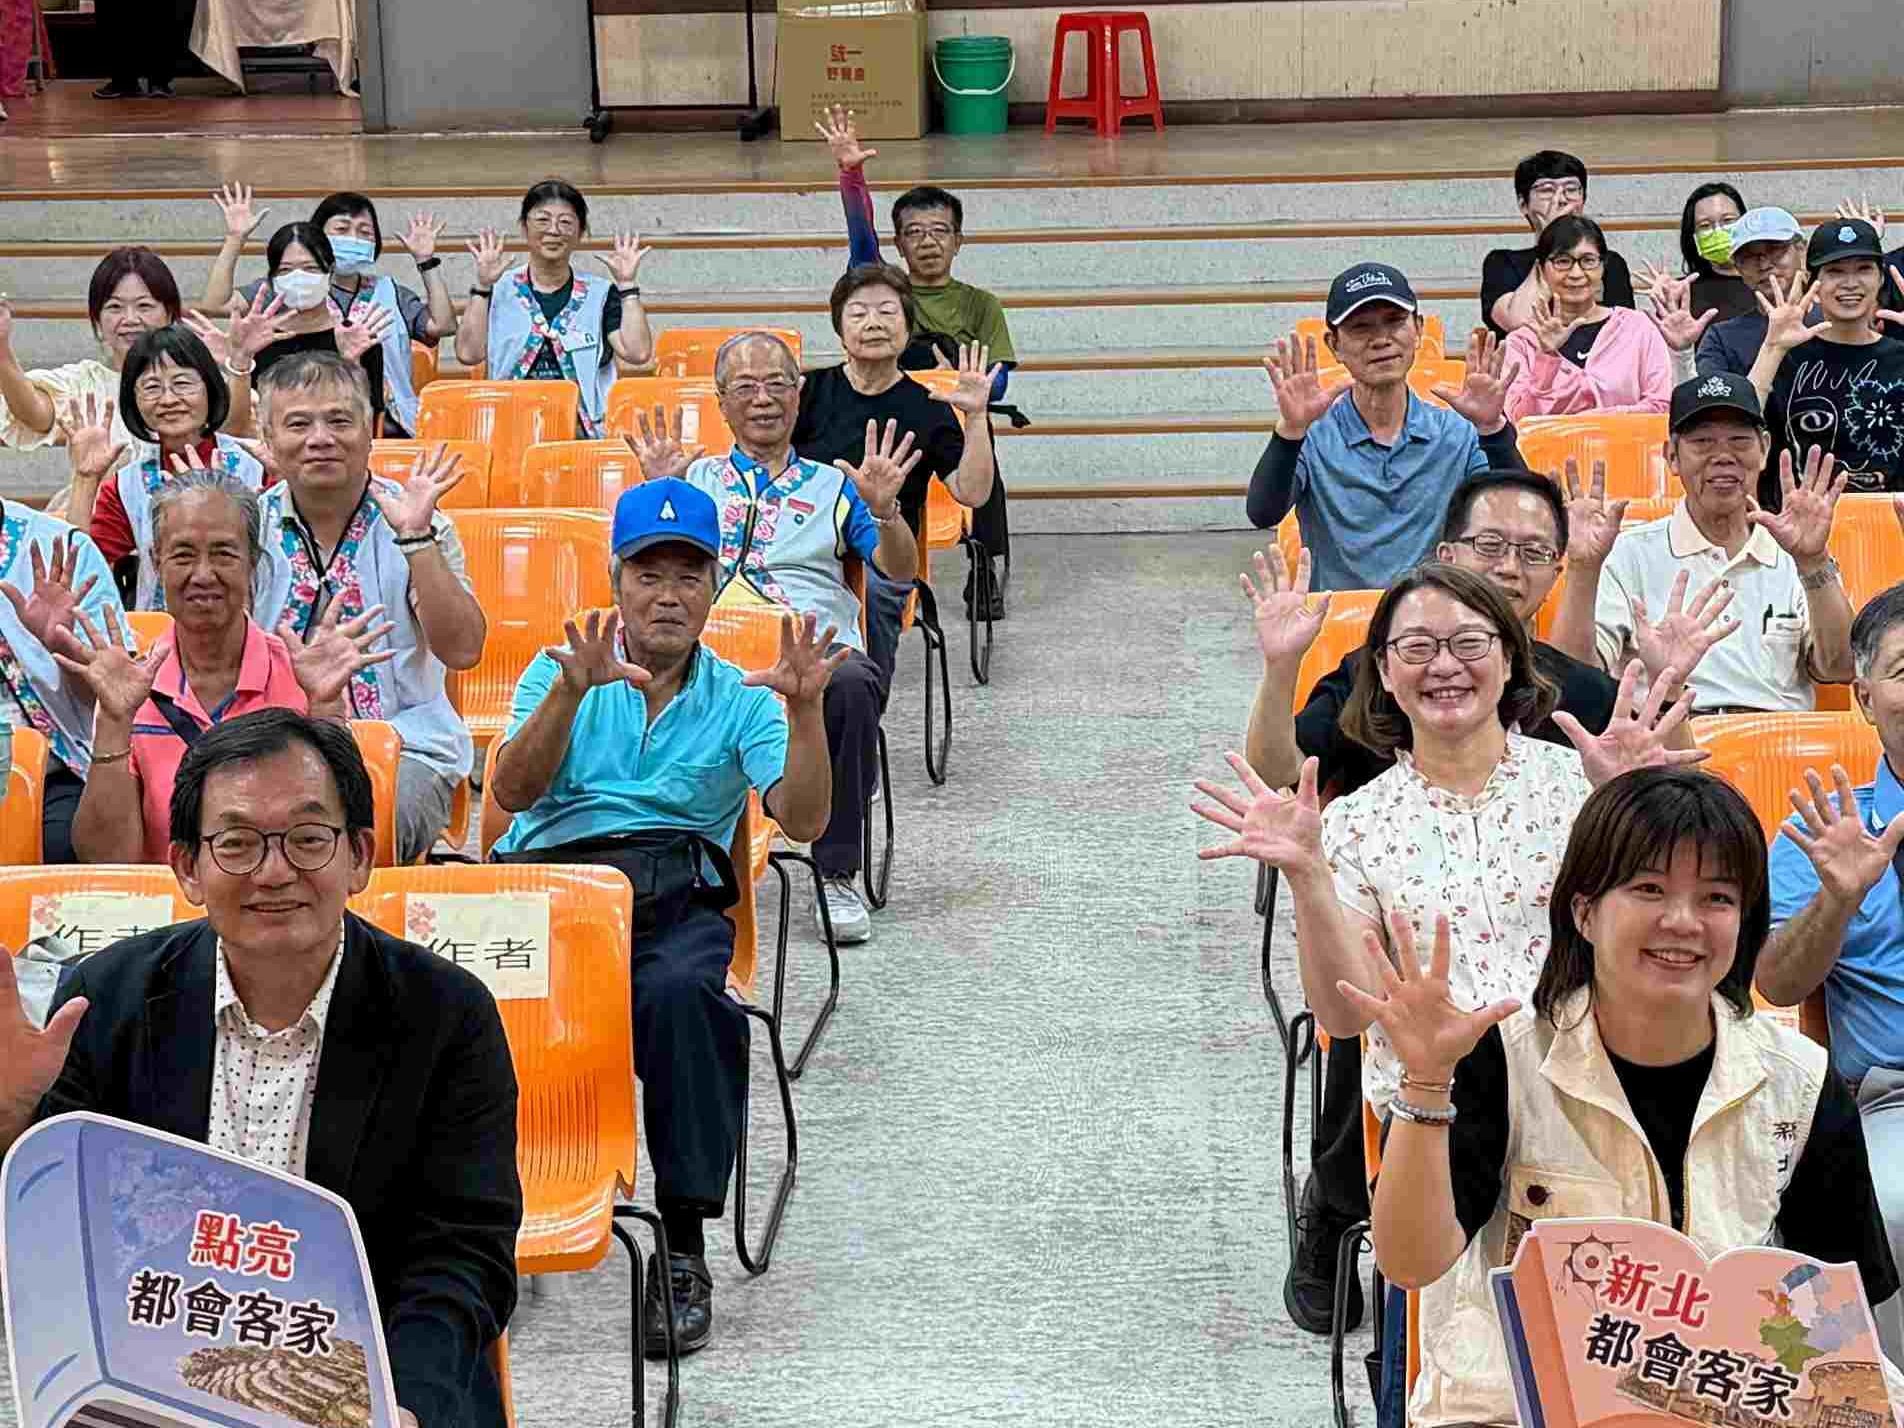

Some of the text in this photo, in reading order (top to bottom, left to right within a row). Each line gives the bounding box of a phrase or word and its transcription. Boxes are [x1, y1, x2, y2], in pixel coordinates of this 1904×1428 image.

[428, 936, 537, 972] 作者
[190, 1211, 299, 1280] 點亮
[128, 1272, 336, 1356] 都會客家
[1601, 1255, 1712, 1327] 新北
[1585, 1314, 1800, 1417] 都會客家
